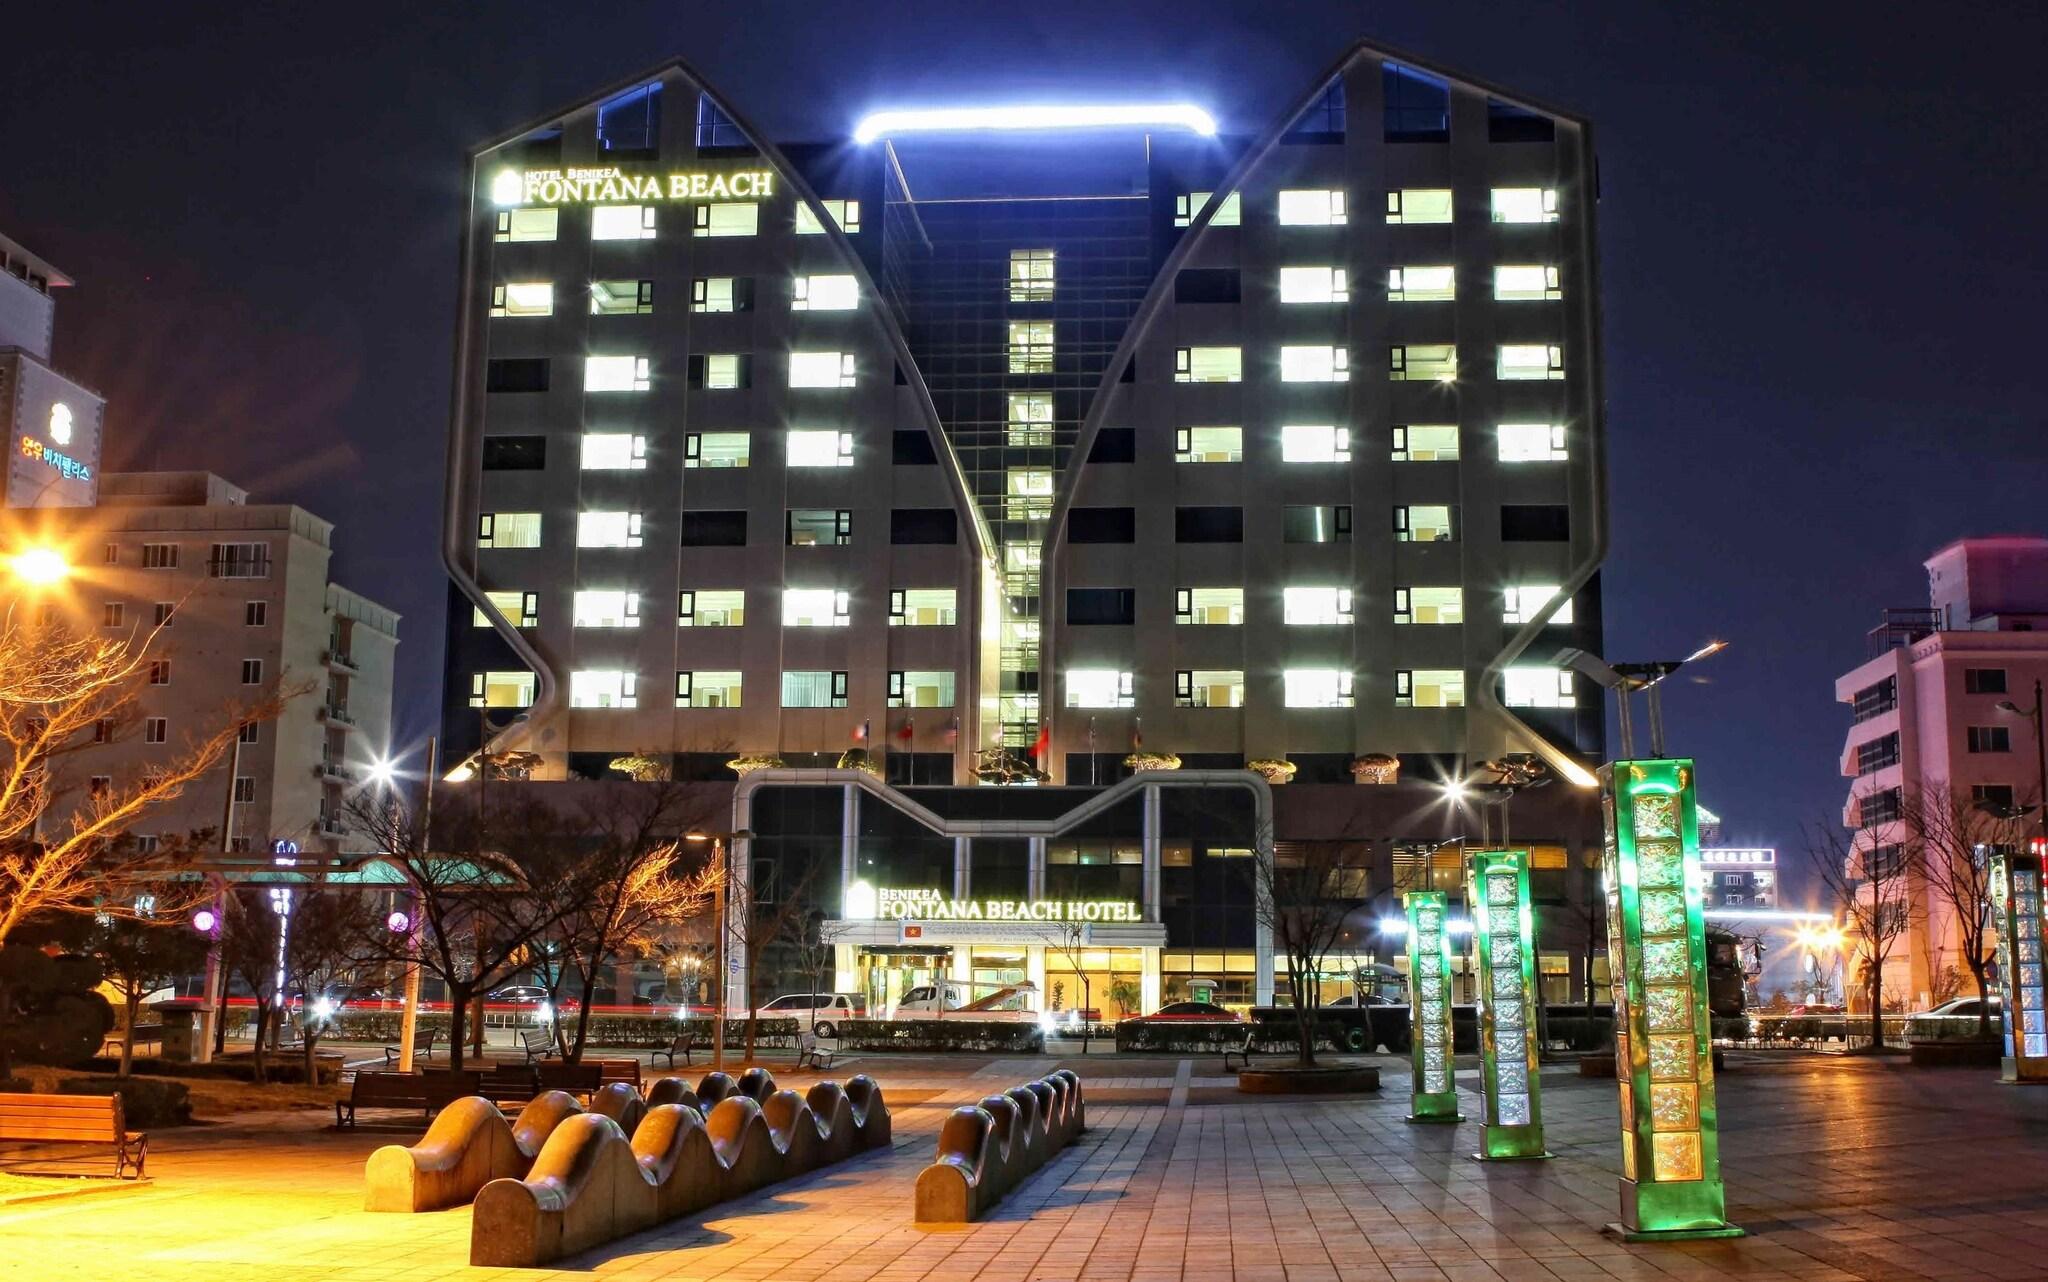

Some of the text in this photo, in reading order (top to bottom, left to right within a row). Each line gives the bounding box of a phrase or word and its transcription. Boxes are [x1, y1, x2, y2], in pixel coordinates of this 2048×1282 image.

[525, 167, 621, 181] HOTEL BENIKEA
[524, 172, 773, 202] FONTANA BEACH
[879, 888, 942, 901] BENIKEA
[878, 900, 1142, 921] FONTANA BEACH HOTEL
